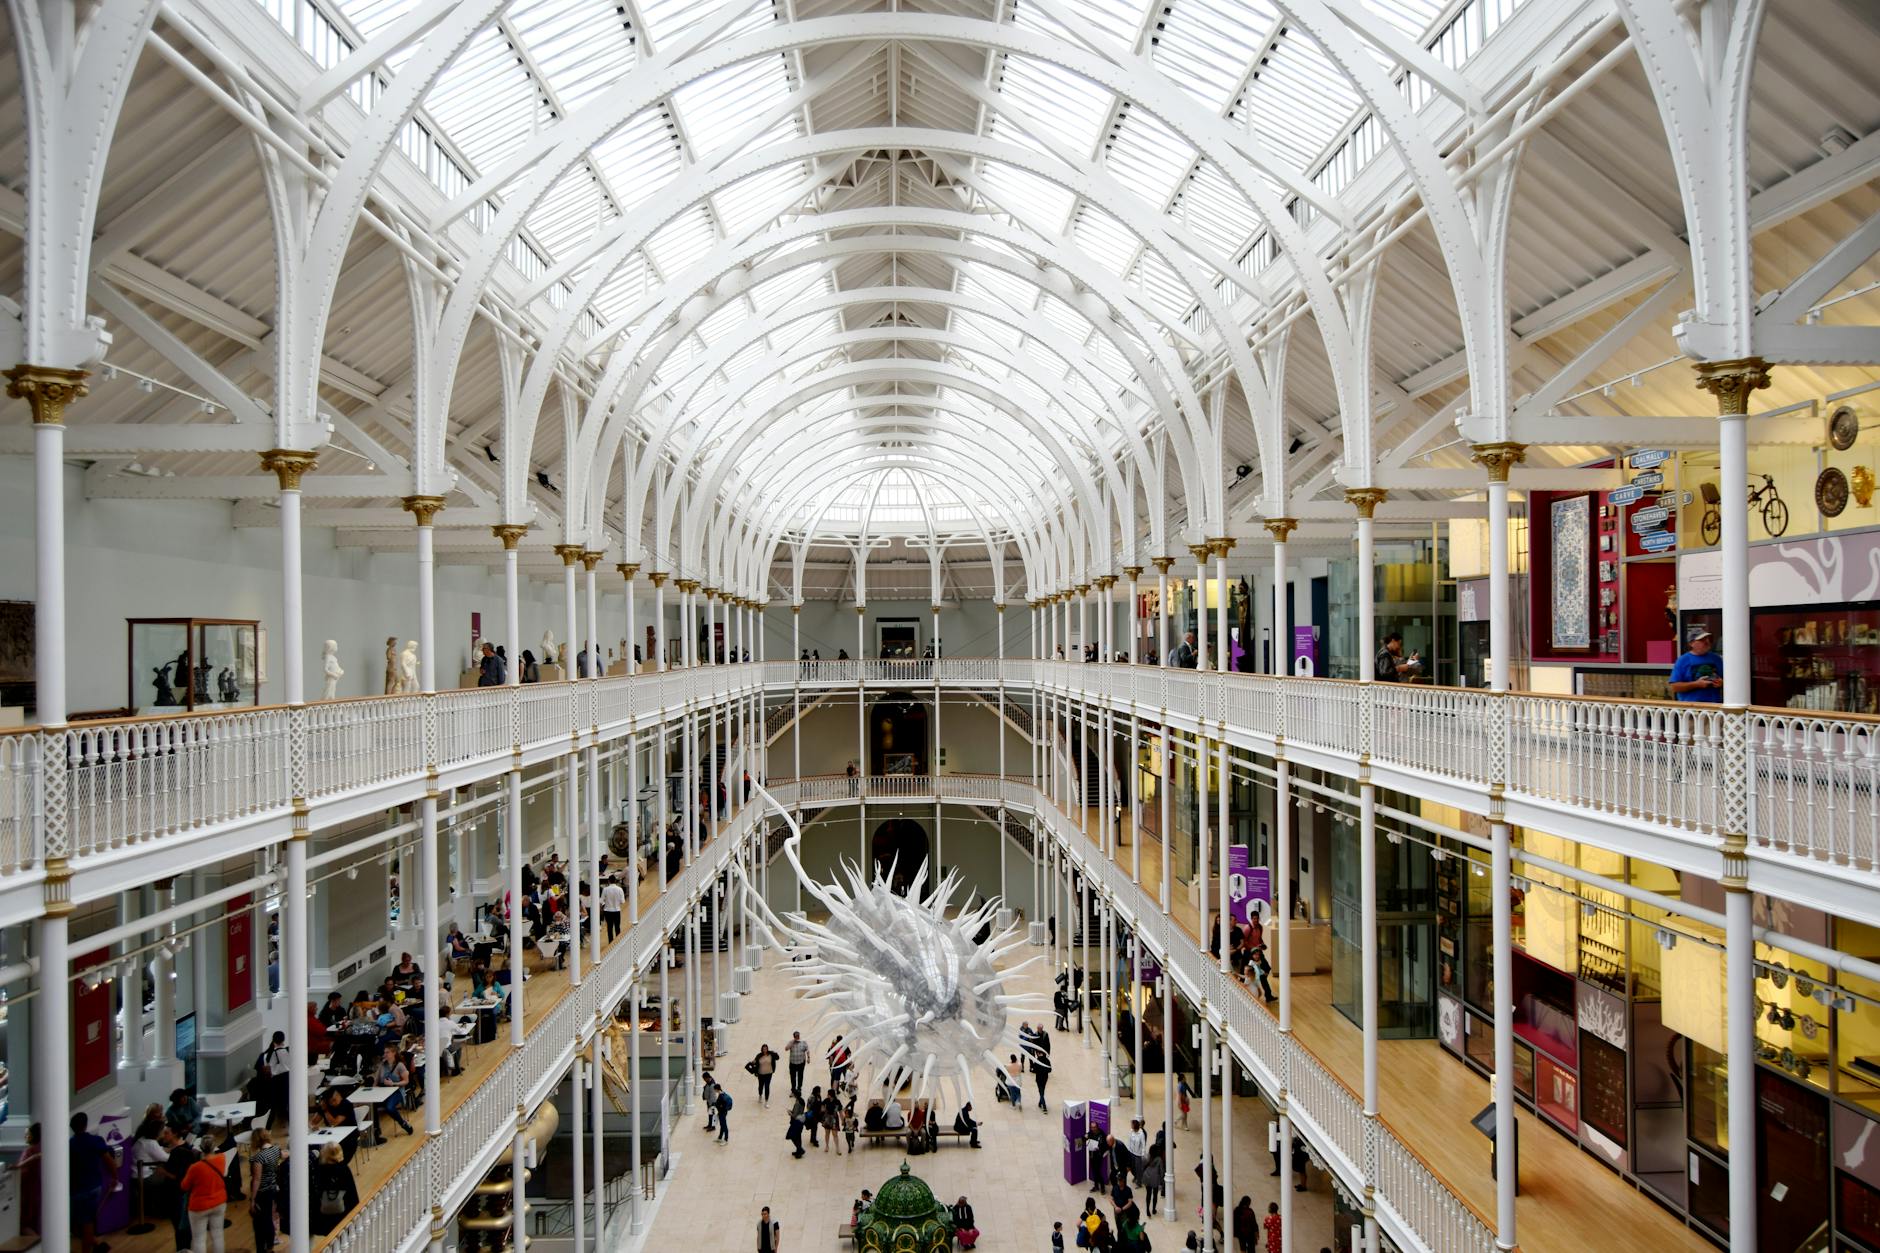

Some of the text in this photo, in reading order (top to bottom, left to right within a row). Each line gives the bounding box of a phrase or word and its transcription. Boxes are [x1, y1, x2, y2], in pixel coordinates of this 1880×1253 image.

[1635, 451, 1664, 464] DALMALLY
[1615, 489, 1635, 500] GARVE
[1633, 510, 1666, 523] STONEHAVEN
